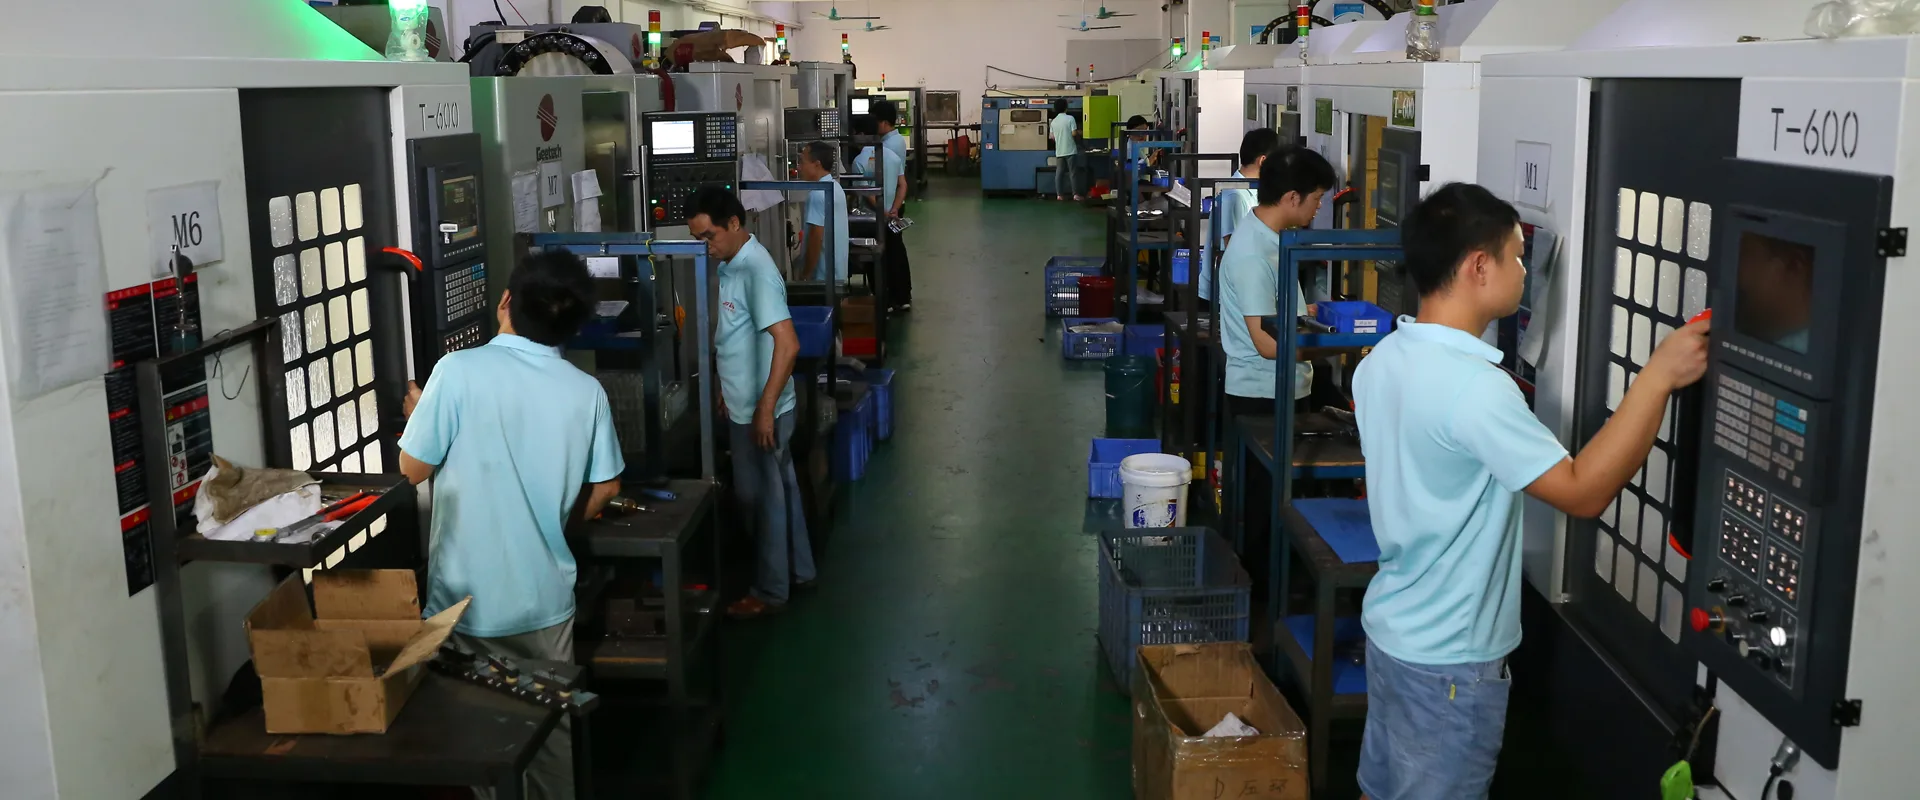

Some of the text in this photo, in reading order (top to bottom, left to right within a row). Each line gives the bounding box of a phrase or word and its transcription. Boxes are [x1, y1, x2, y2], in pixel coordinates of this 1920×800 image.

[419, 102, 459, 131] T-600
[1394, 97, 1415, 119] T-600
[1771, 107, 1859, 159] T-600
[536, 143, 562, 162] Geetech
[547, 174, 558, 196] M7
[1525, 162, 1538, 191] M1
[171, 210, 203, 249] M6
